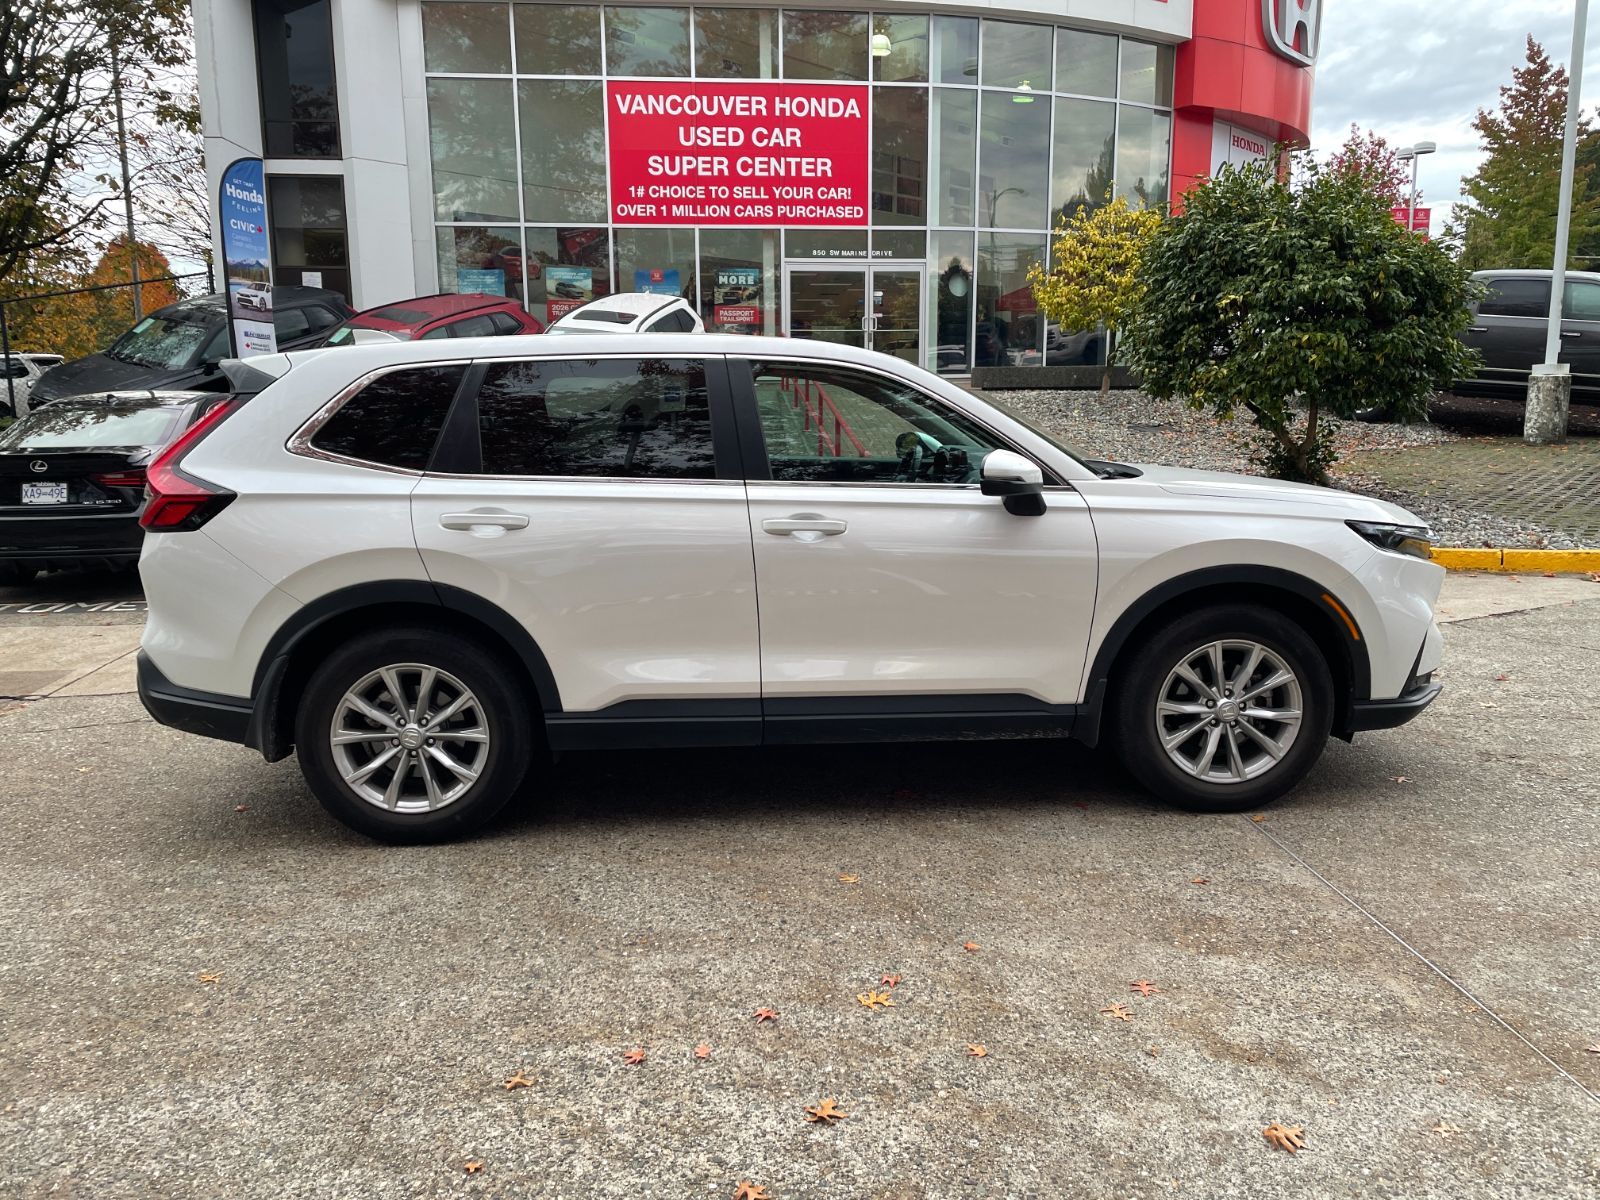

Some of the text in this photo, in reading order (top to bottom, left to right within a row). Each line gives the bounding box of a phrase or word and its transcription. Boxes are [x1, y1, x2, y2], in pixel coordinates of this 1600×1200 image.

[615, 94, 861, 118] VANCOUVER HONDA
[679, 126, 801, 147] USED CAR
[1232, 134, 1265, 156] HONDA
[647, 155, 832, 177] SUPER CENTER
[225, 183, 264, 204] Honda
[628, 185, 852, 200] 1# CHOICE TO SELL YOUR CAR!
[616, 204, 864, 218] OVER 1 MILLION CARS PURCHASED
[230, 219, 256, 233] CIVIC
[719, 275, 754, 284] MORE
